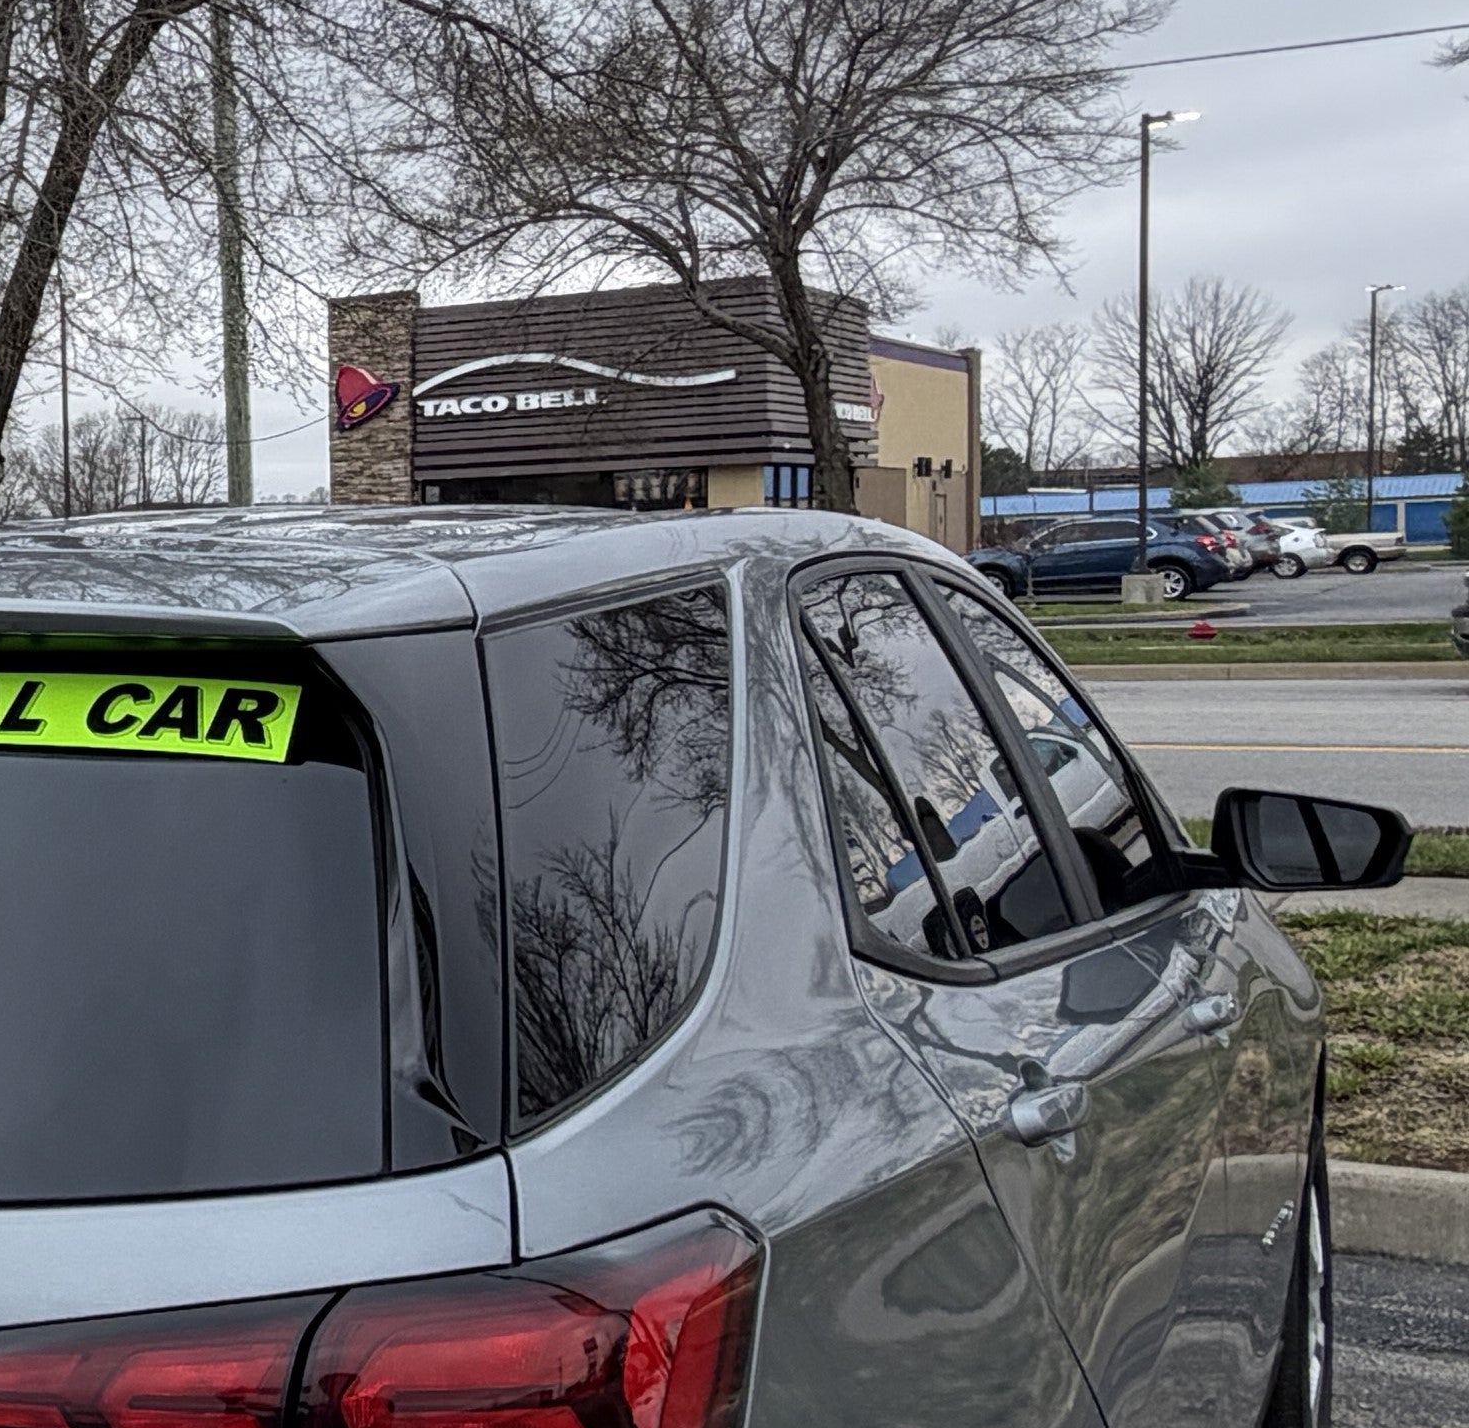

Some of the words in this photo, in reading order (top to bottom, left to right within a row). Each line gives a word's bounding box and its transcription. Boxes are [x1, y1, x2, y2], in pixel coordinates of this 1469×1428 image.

[417, 395, 510, 417] TACO
[516, 388, 608, 411] BELL
[86, 683, 286, 749] CAR
